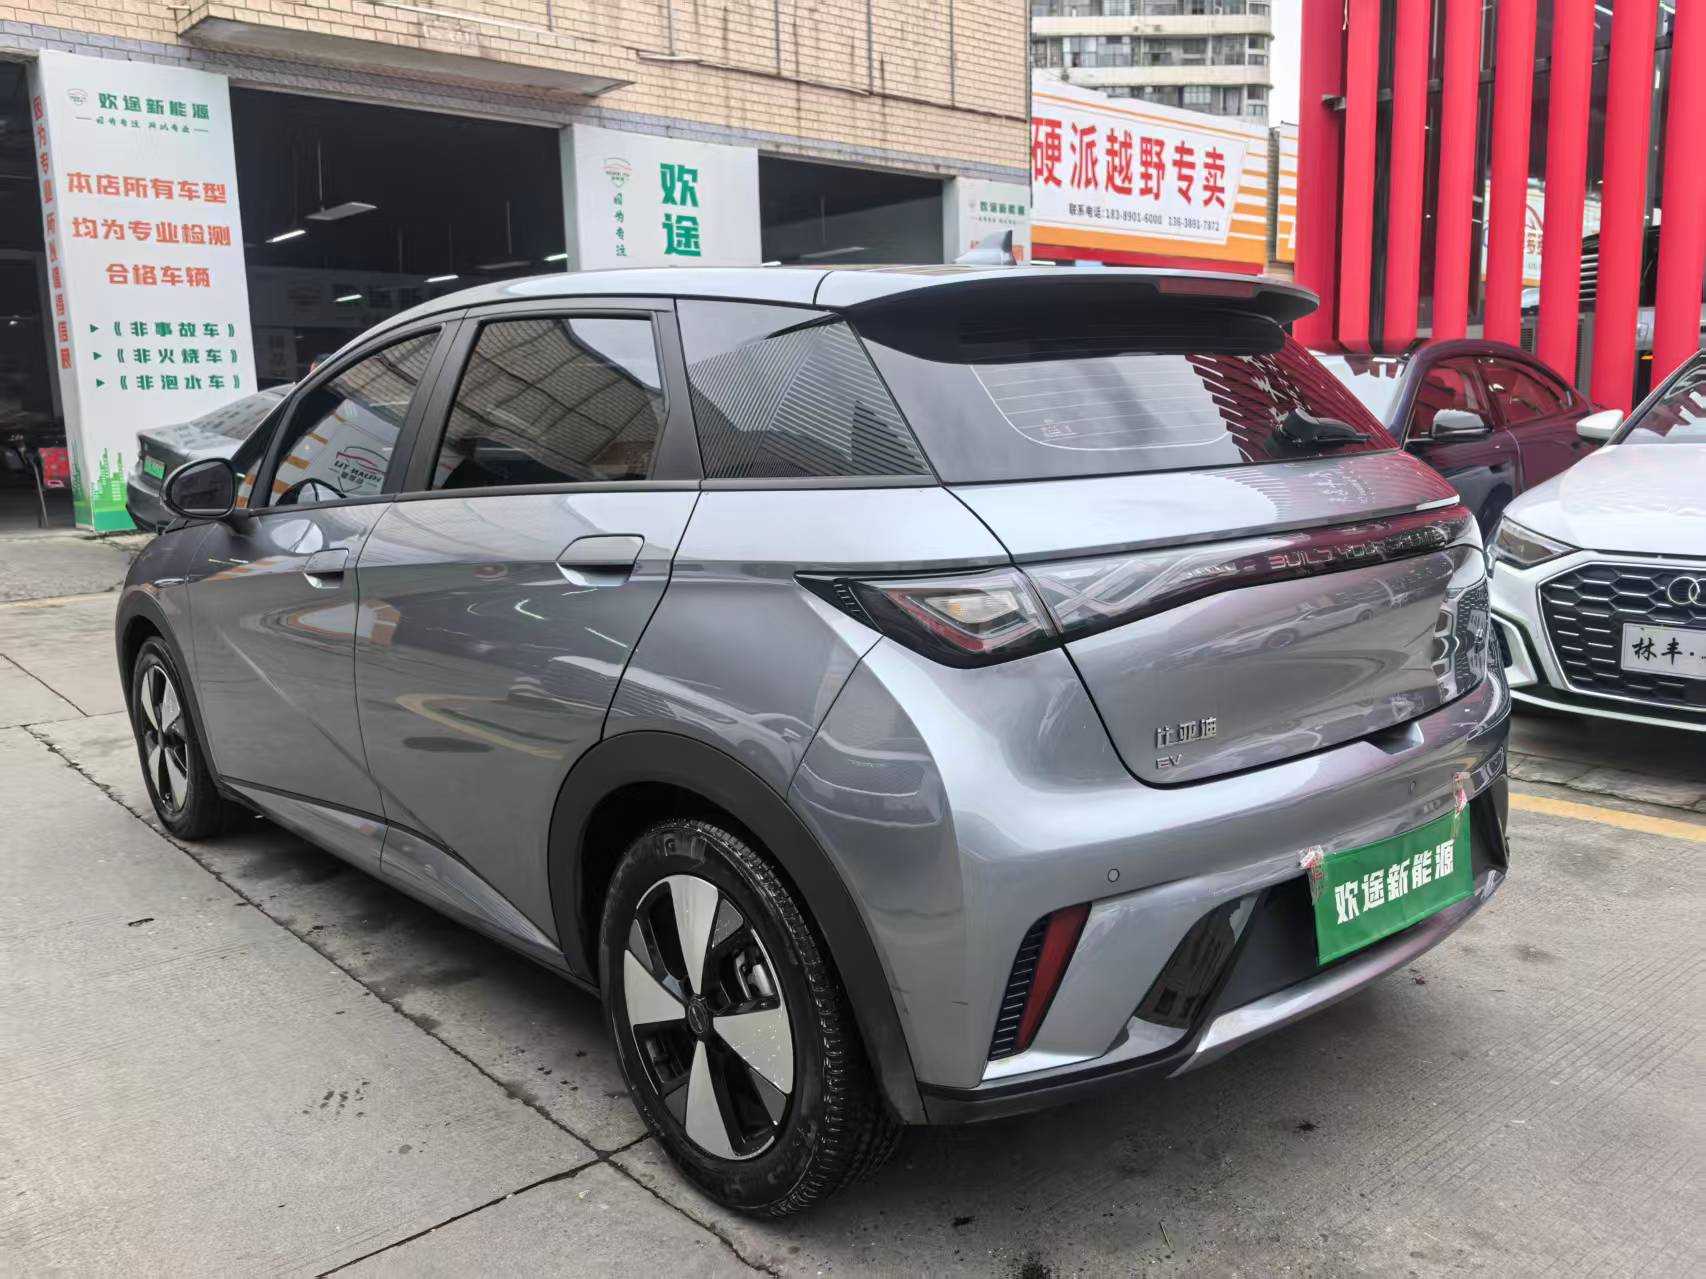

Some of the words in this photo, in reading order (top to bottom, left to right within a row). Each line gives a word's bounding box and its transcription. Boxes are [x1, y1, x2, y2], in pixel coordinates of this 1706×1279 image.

[98, 92, 210, 120] 欢途新能源
[1031, 117, 1226, 209] 硬派越野专卖
[67, 172, 228, 204] 本店所有车型
[660, 161, 703, 257] 欢途
[71, 217, 232, 247] 均为专业检测
[105, 262, 212, 289] 合格车辆
[114, 321, 236, 338] 《非事故车》
[117, 348, 239, 364] 《非火烧车》
[120, 375, 241, 391] 《非泡水车》
[1156, 753, 1184, 770] EV
[1333, 838, 1456, 925] 欢途新能源
